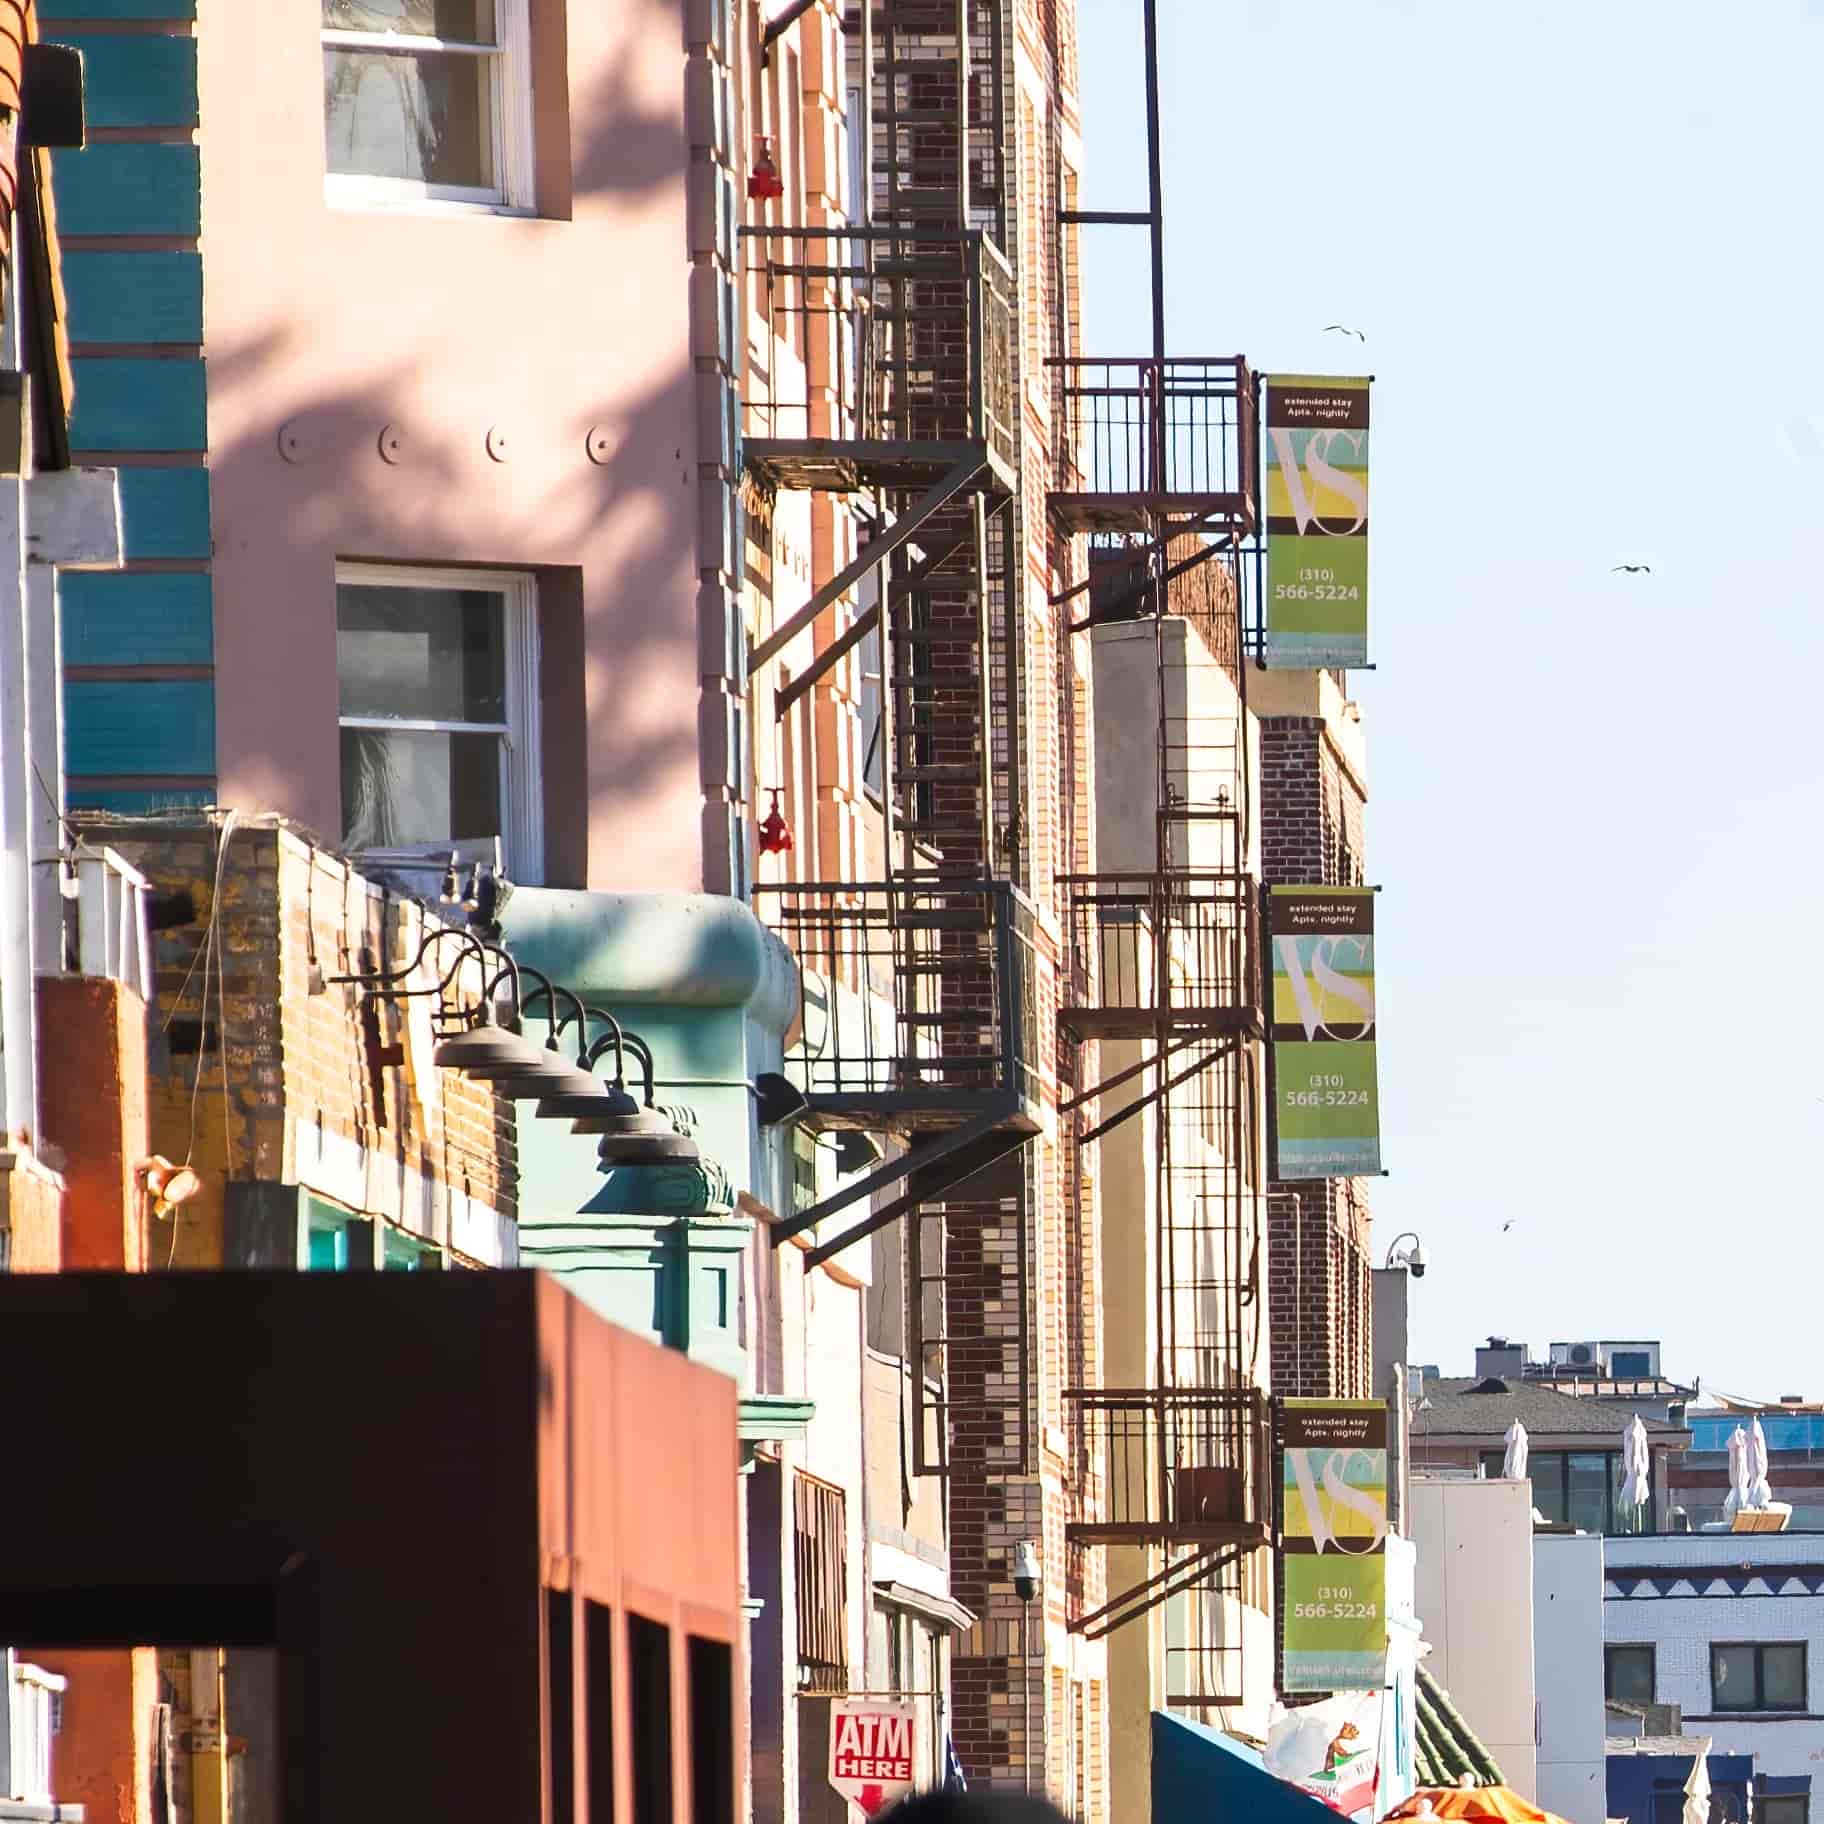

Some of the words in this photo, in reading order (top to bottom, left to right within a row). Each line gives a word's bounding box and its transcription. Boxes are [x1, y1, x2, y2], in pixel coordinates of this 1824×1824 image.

[1284, 398, 1330, 407] extended
[1332, 398, 1352, 408] stay
[1316, 408, 1350, 419] nightly
[1299, 568, 1334, 583] (310)
[1275, 585, 1359, 600] 566-5224
[1289, 904, 1334, 913] extended
[1336, 905, 1356, 914] stay
[1320, 914, 1355, 925] nightly
[1309, 1074, 1344, 1088] (310)
[1286, 1090, 1369, 1106] 566-5224
[1301, 1418, 1347, 1426] extended
[1348, 1419, 1369, 1428] stay
[1333, 1428, 1367, 1439] nightly
[1317, 1586, 1352, 1601] (310)
[1294, 1603, 1377, 1618] 566-5224
[837, 1716, 910, 1758] ATM
[838, 1760, 910, 1778] HERE
